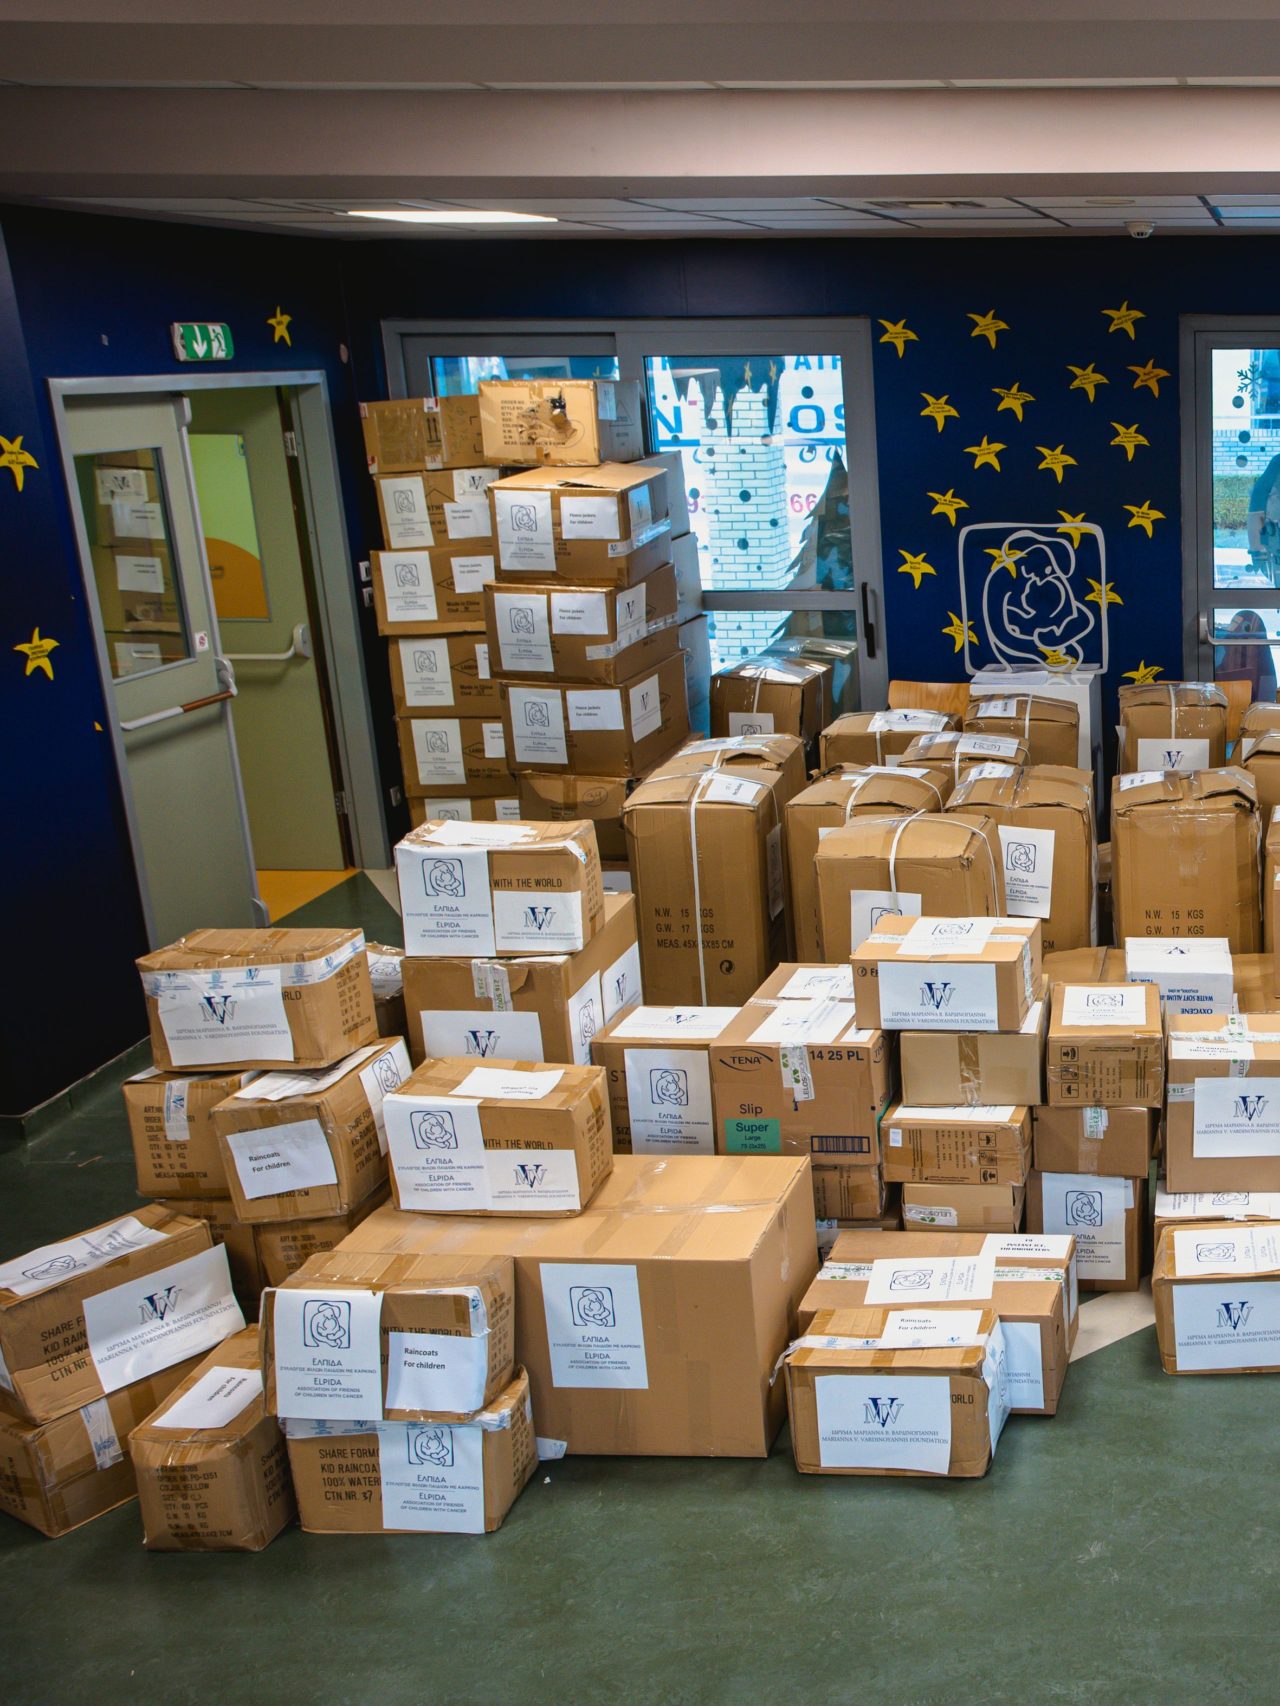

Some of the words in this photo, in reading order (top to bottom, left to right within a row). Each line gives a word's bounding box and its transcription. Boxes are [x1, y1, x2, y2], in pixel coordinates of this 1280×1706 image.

[494, 879, 512, 887] WITH
[516, 878, 532, 887] THE
[536, 879, 562, 887] WORLD
[655, 908, 672, 917] N.W.
[681, 909, 689, 917] 15
[1146, 911, 1162, 919] N.W.
[1188, 910, 1204, 918] KGS
[656, 924, 673, 932] G.W.
[701, 924, 714, 933] GS
[1146, 926, 1163, 935] G.W.
[1188, 926, 1204, 934] KGS
[722, 940, 734, 948] CM
[810, 1051, 823, 1060] 14
[828, 1051, 843, 1060] 25
[847, 1051, 864, 1060] PL
[739, 1104, 763, 1115] Slip
[736, 1123, 768, 1133] Super
[249, 1151, 280, 1162] Raincoats
[265, 1161, 291, 1170] children
[41, 1320, 75, 1341] SHARE
[43, 1343, 60, 1355] KID
[405, 1348, 438, 1356] Raincoats
[314, 1378, 342, 1386] ELPIDA
[950, 1395, 974, 1404] ORLD
[319, 1449, 349, 1459] SHARE
[351, 1449, 379, 1459] FORM
[321, 1464, 334, 1473] KID
[338, 1464, 380, 1473] RAINCOA
[323, 1477, 345, 1486] 100%
[350, 1477, 381, 1486] WATER
[419, 1493, 446, 1501] ELPIDA
